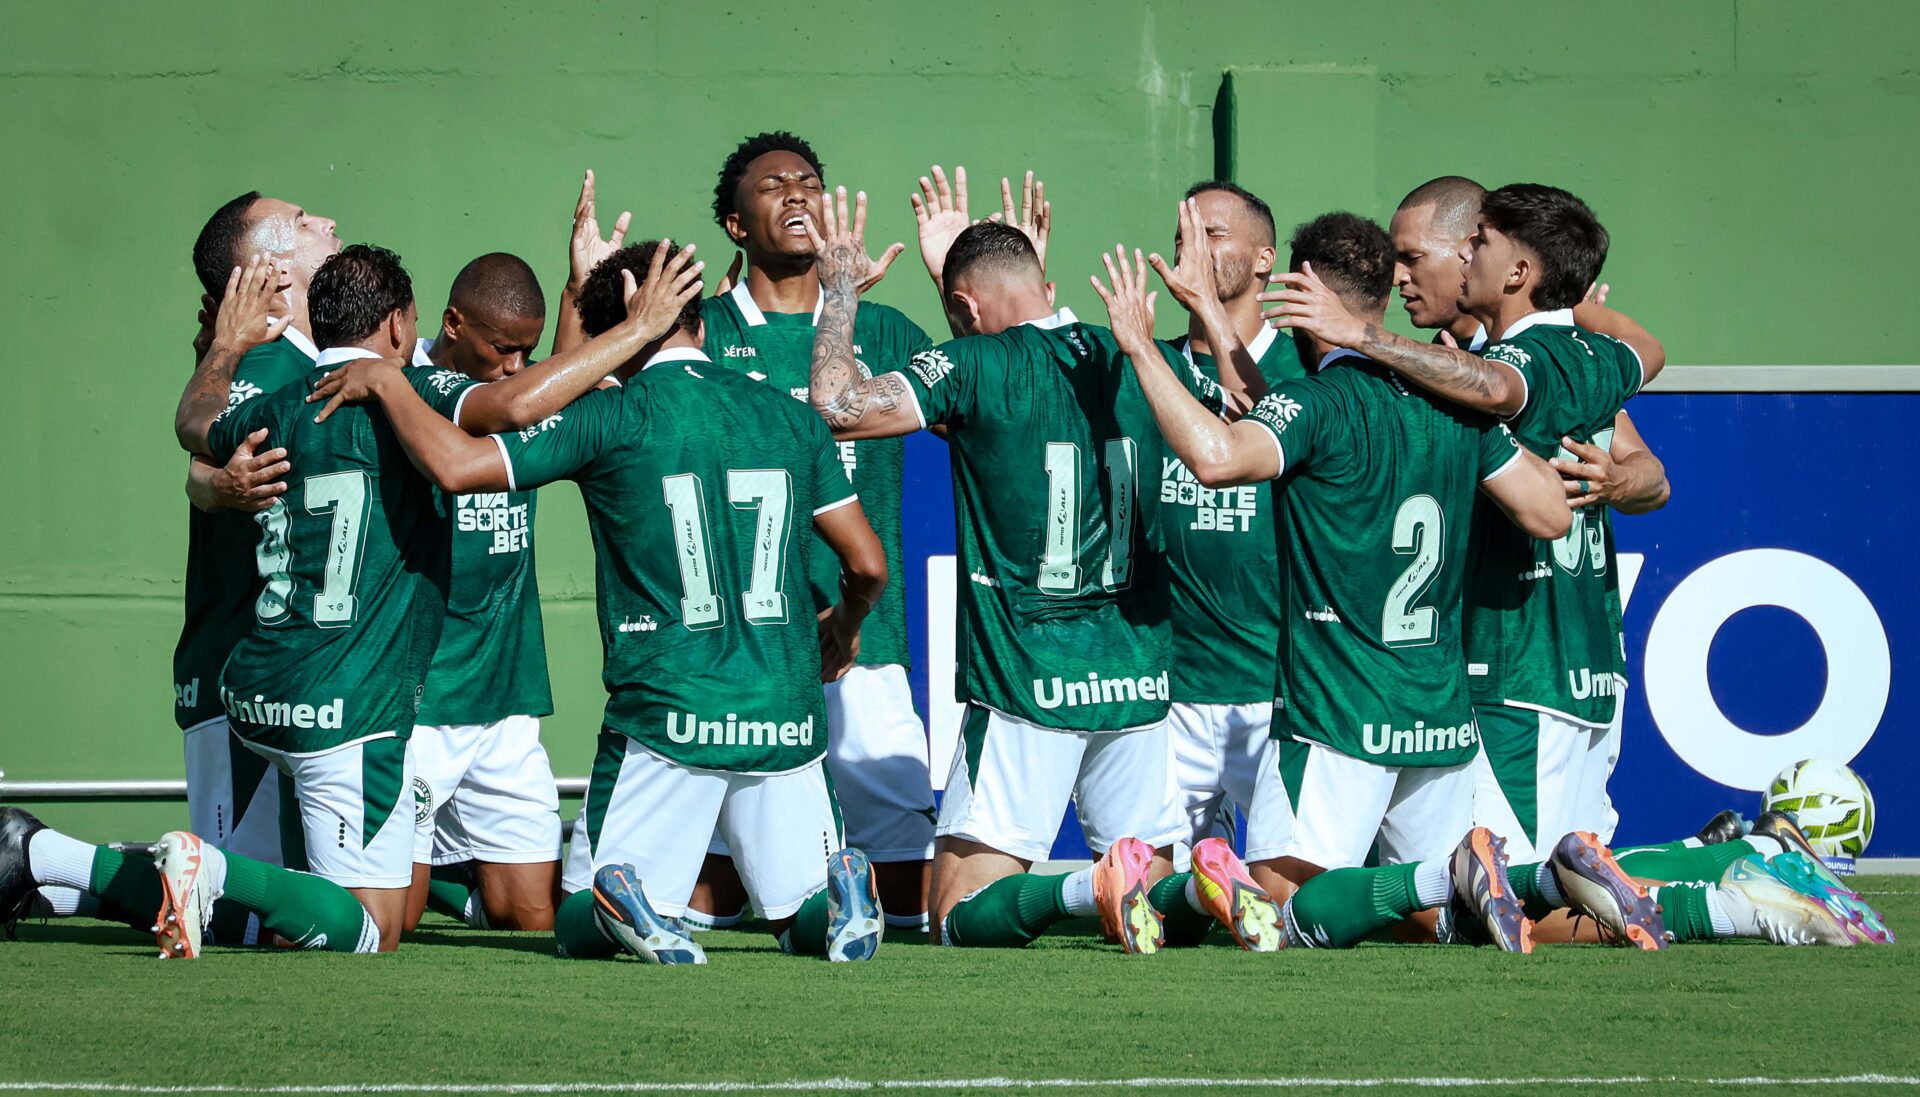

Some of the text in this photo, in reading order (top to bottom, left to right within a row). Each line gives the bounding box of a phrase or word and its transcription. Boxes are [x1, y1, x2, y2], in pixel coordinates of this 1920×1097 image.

[1160, 480, 1257, 509] SORTE
[457, 503, 528, 532] SORTE
[1037, 437, 1139, 596] 11
[1190, 507, 1257, 532] .BET
[489, 526, 529, 555] .BET
[662, 468, 794, 632] 17
[1381, 493, 1446, 649] 2
[219, 685, 345, 730] Unimed
[1033, 671, 1170, 709] Unimed
[666, 711, 814, 747] Unimed
